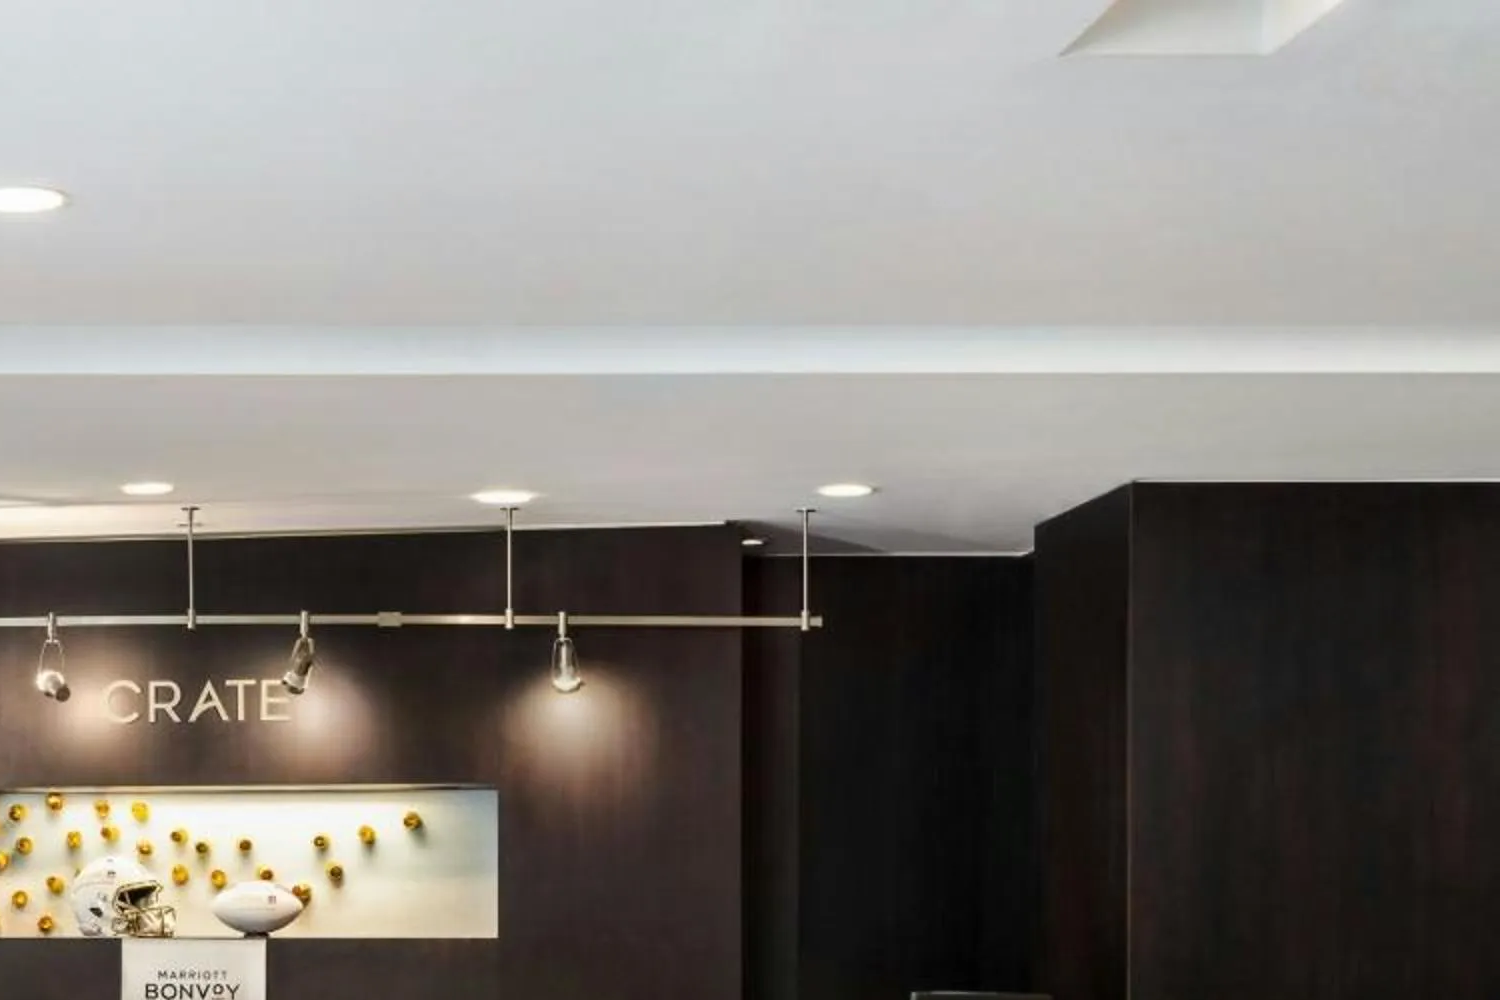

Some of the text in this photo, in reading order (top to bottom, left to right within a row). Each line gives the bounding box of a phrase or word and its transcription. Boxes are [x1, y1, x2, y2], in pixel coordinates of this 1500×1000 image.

[101, 678, 292, 723] CRATE
[157, 970, 228, 981] MARRIOTT
[145, 983, 240, 1000] BONVOY
